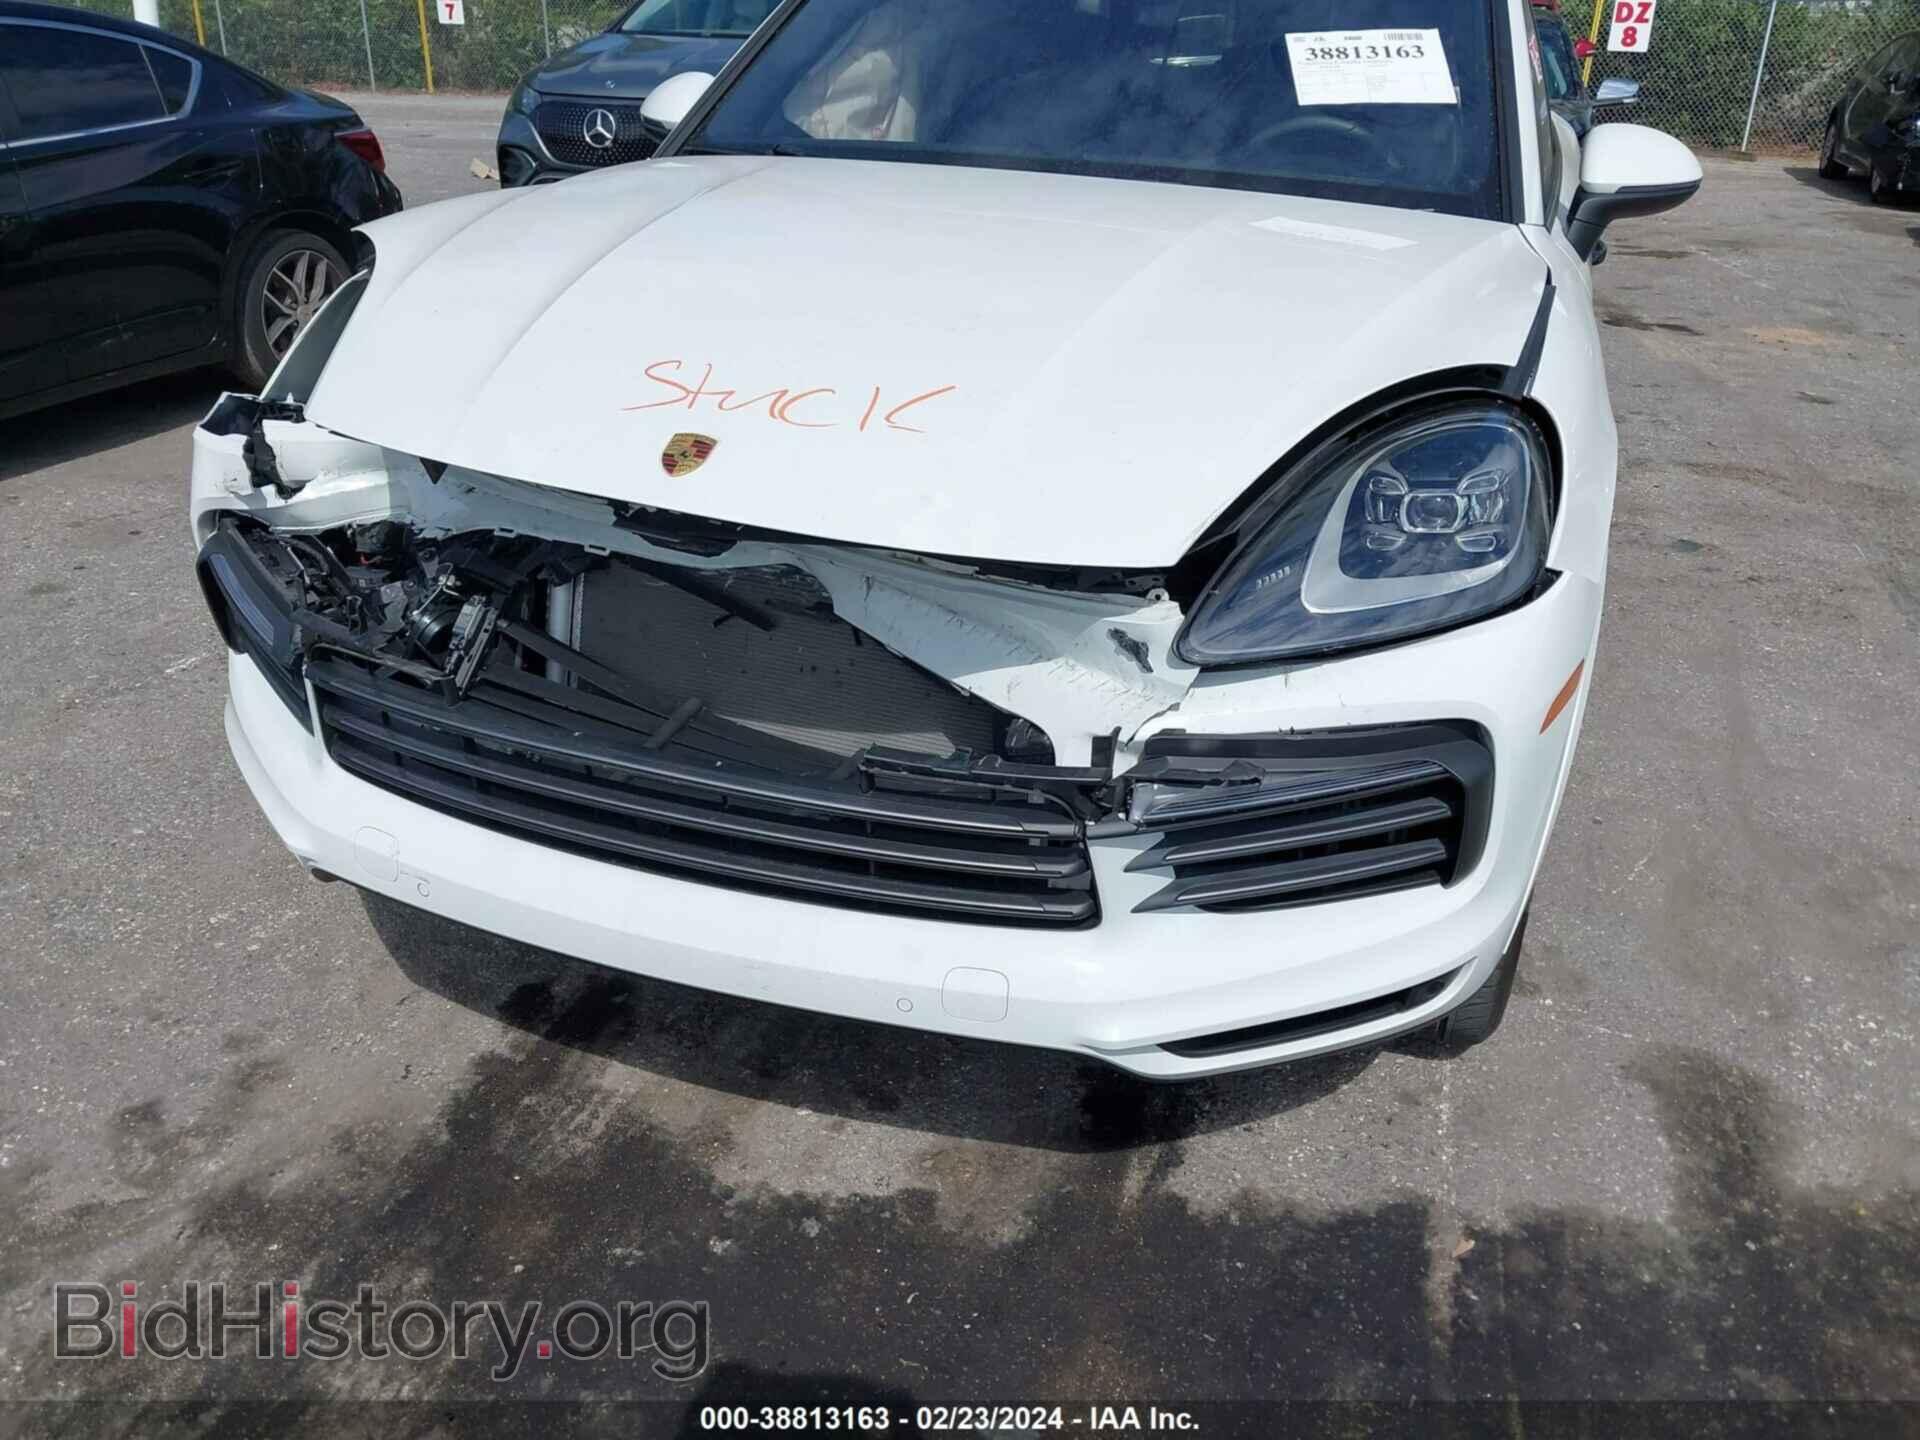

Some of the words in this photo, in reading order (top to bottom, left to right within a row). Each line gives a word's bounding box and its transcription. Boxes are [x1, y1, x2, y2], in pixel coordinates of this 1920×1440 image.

[445, 3, 455, 20] 7
[1615, 1, 1652, 24] DZ
[1621, 26, 1637, 48] 8
[1304, 44, 1425, 61] 38813163
